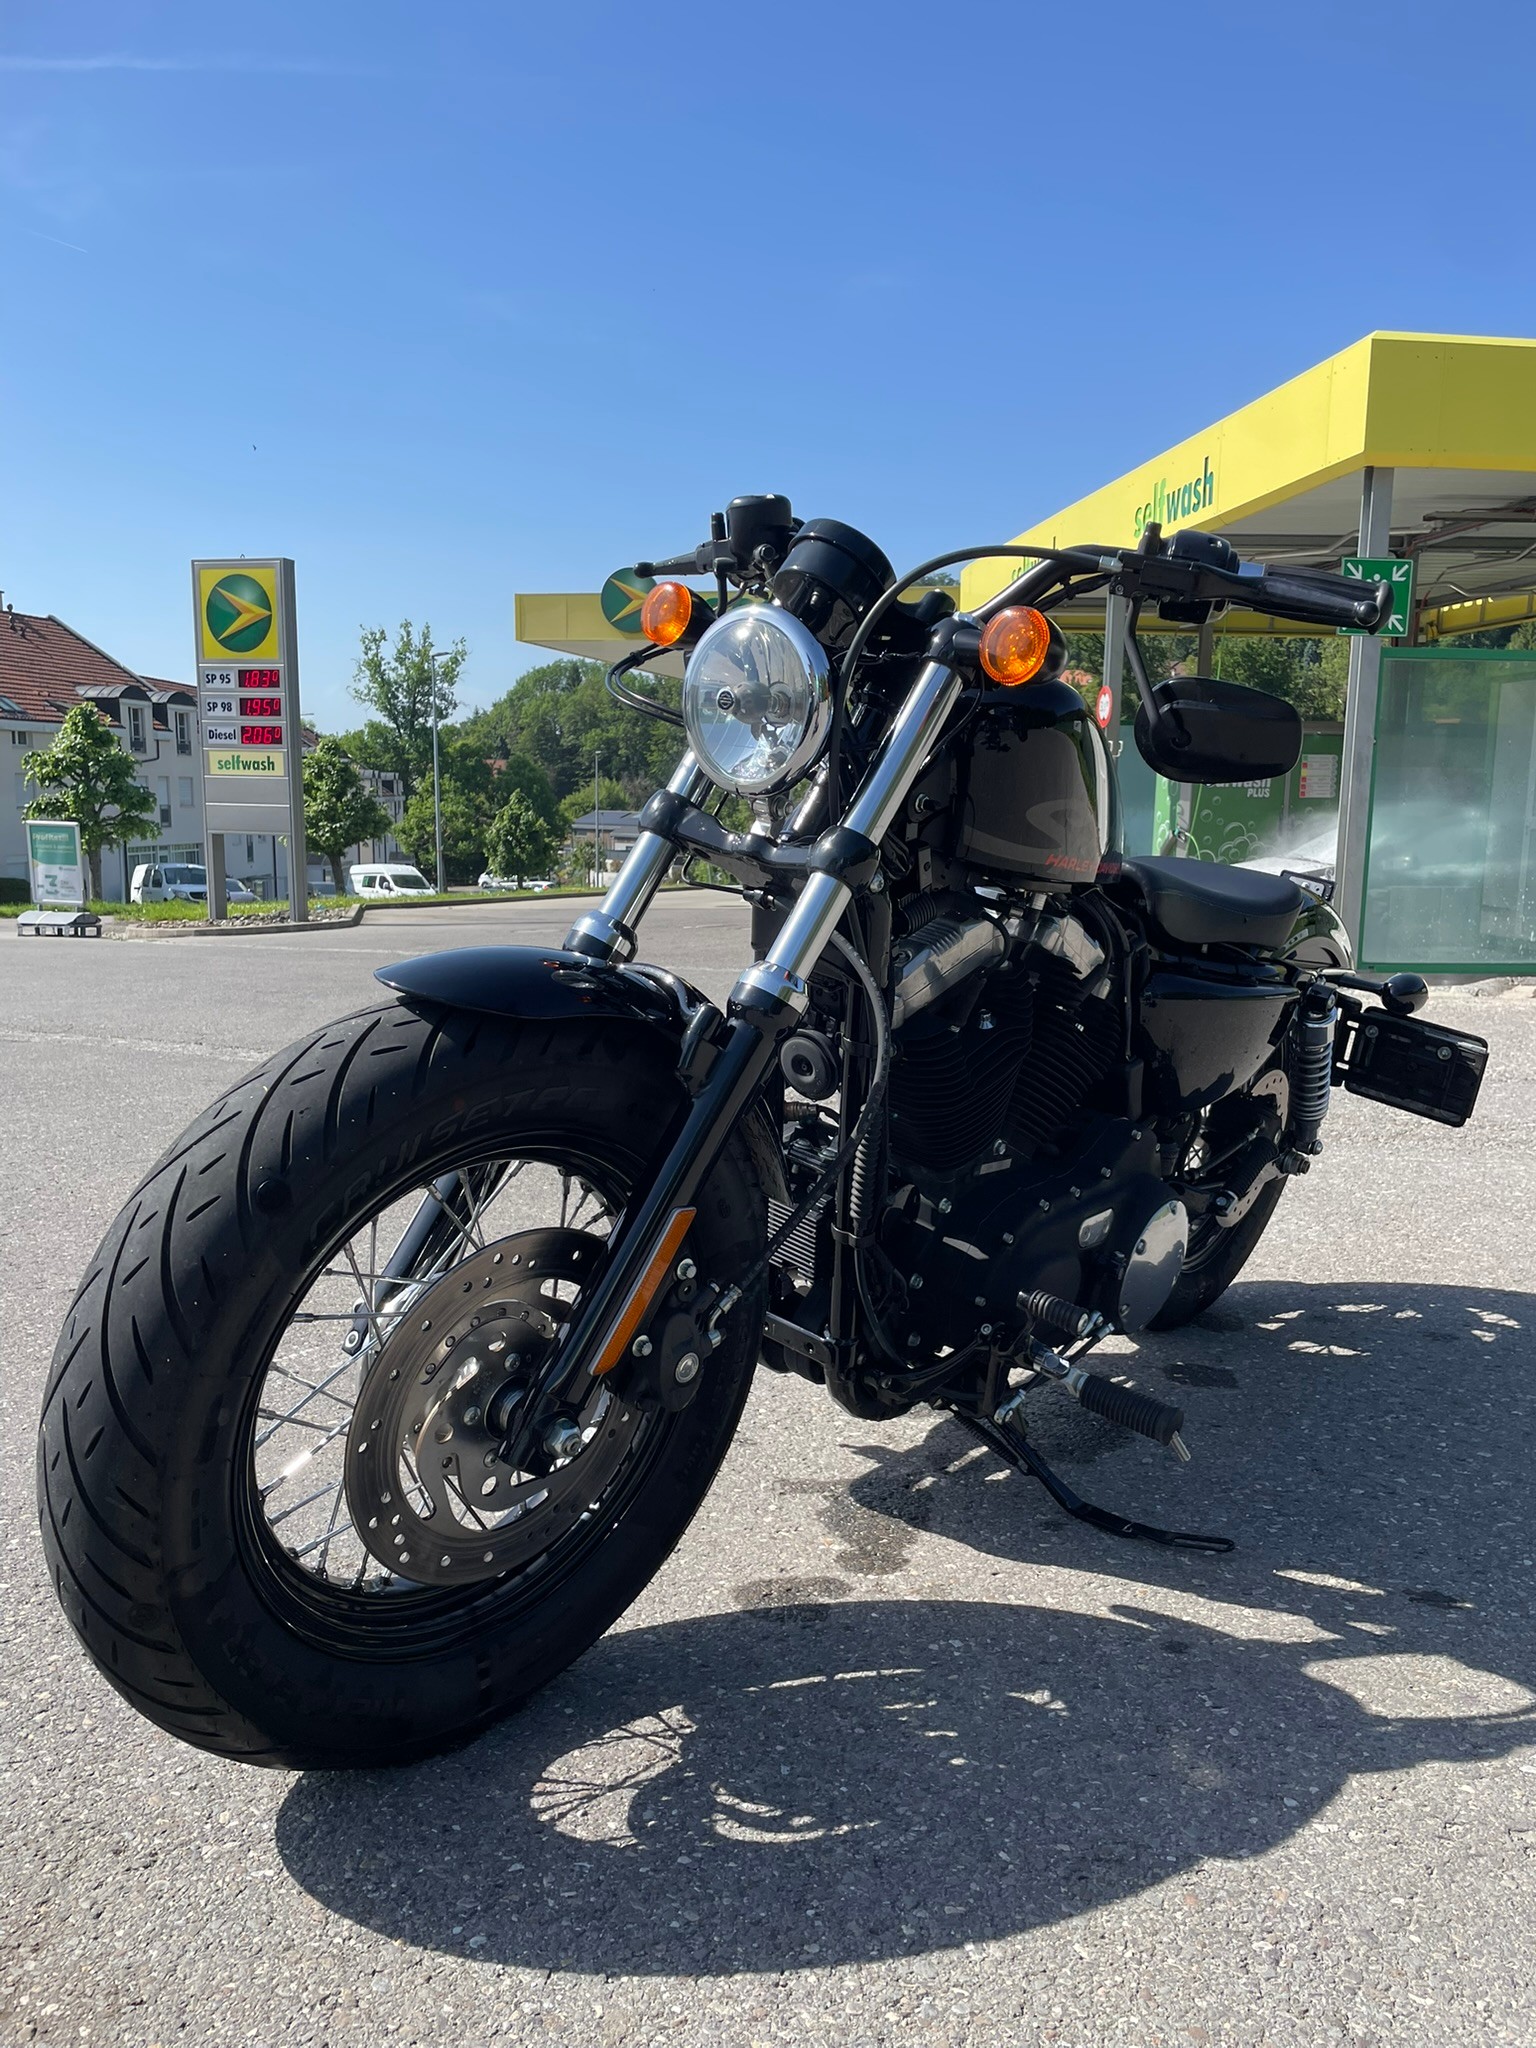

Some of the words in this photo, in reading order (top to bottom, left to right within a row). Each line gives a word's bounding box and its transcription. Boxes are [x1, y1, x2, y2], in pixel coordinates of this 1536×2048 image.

[1133, 455, 1215, 539] selfwash
[205, 673, 217, 684] SP
[219, 673, 231, 684] 95
[207, 701, 218, 712] SP
[221, 701, 232, 712] 98
[208, 728, 236, 740] Diesel
[217, 754, 275, 771] selfwash
[1246, 788, 1270, 798] PLUS
